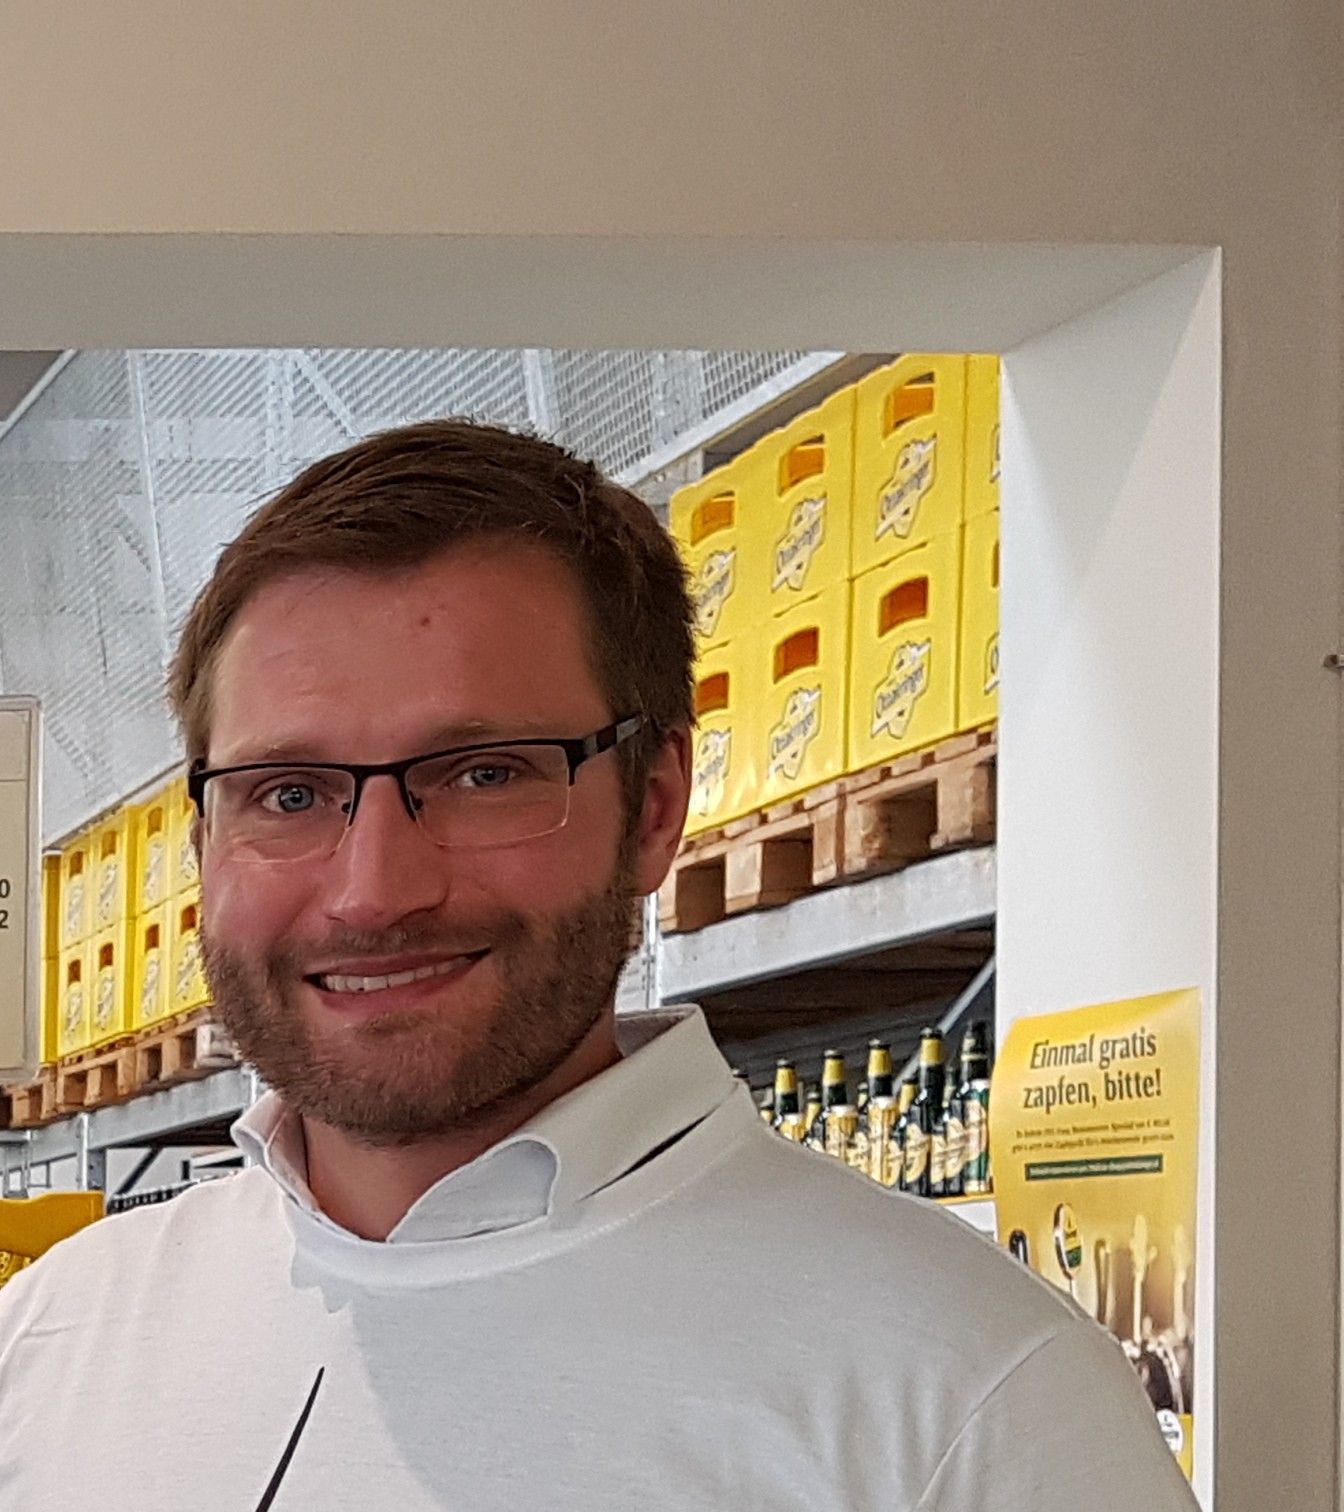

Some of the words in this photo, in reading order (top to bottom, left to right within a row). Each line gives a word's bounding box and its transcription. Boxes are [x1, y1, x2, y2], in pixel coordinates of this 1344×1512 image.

[1030, 1033, 1095, 1069] Einmal
[1098, 1027, 1157, 1070] gratis
[1023, 1075, 1097, 1114] zapfen,
[1104, 1068, 1162, 1101] bitte!
